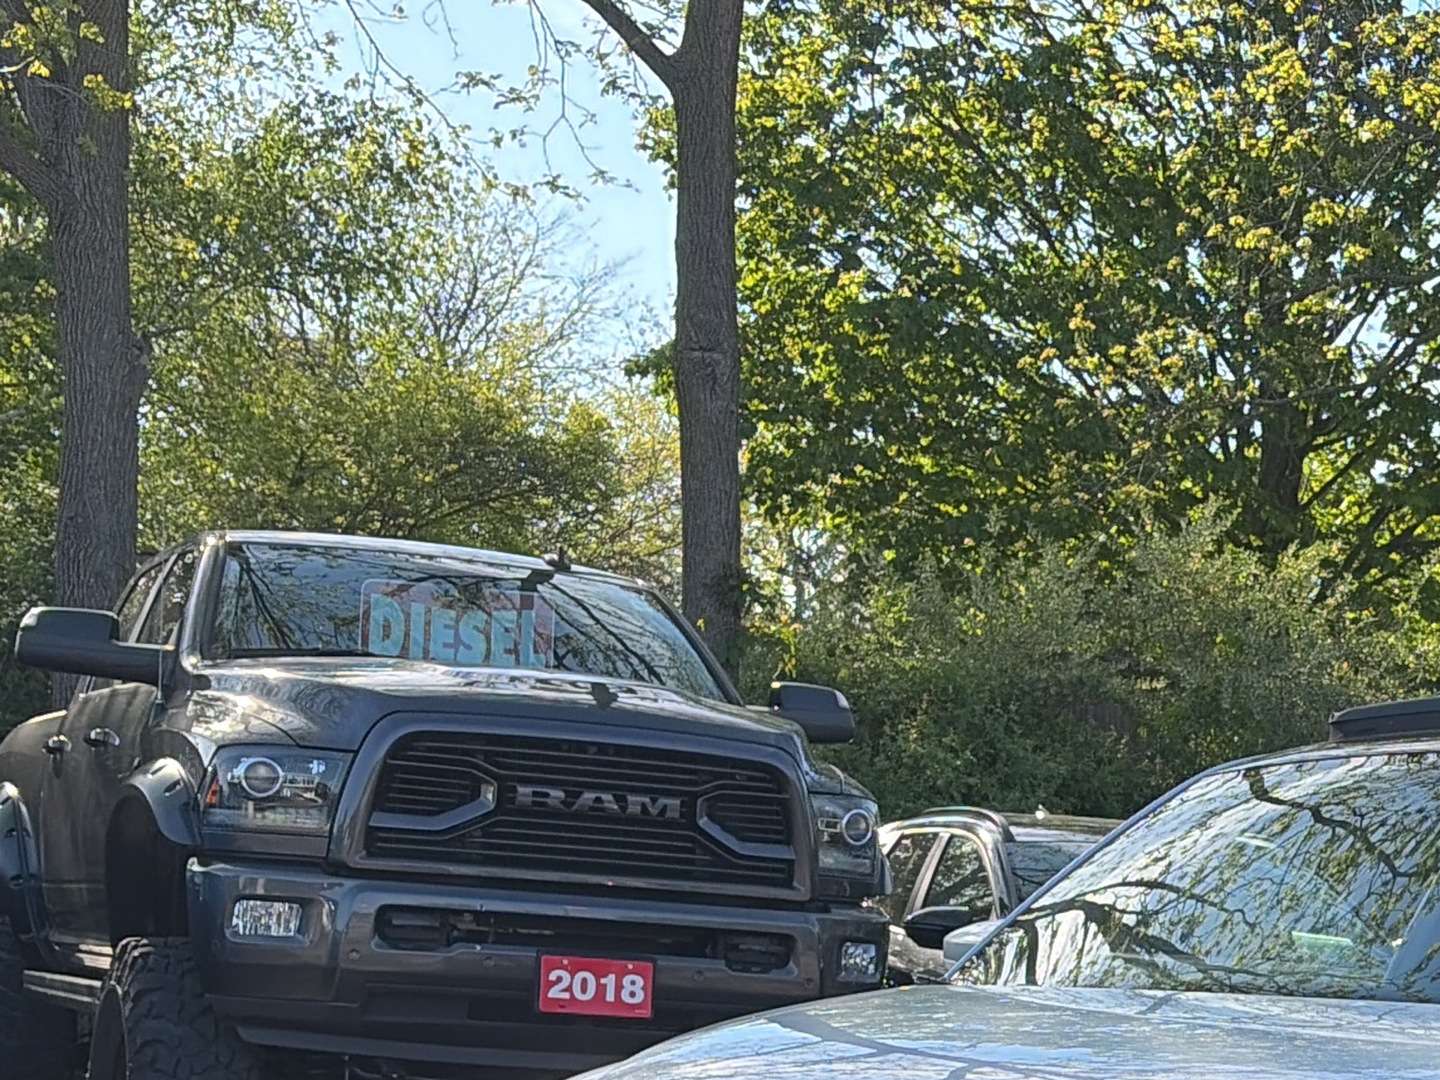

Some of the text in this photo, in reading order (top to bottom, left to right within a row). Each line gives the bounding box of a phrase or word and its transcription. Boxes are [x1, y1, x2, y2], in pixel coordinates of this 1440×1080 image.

[368, 592, 546, 668] DIESEL
[515, 784, 681, 819] RAM
[547, 969, 645, 1005] 2018
